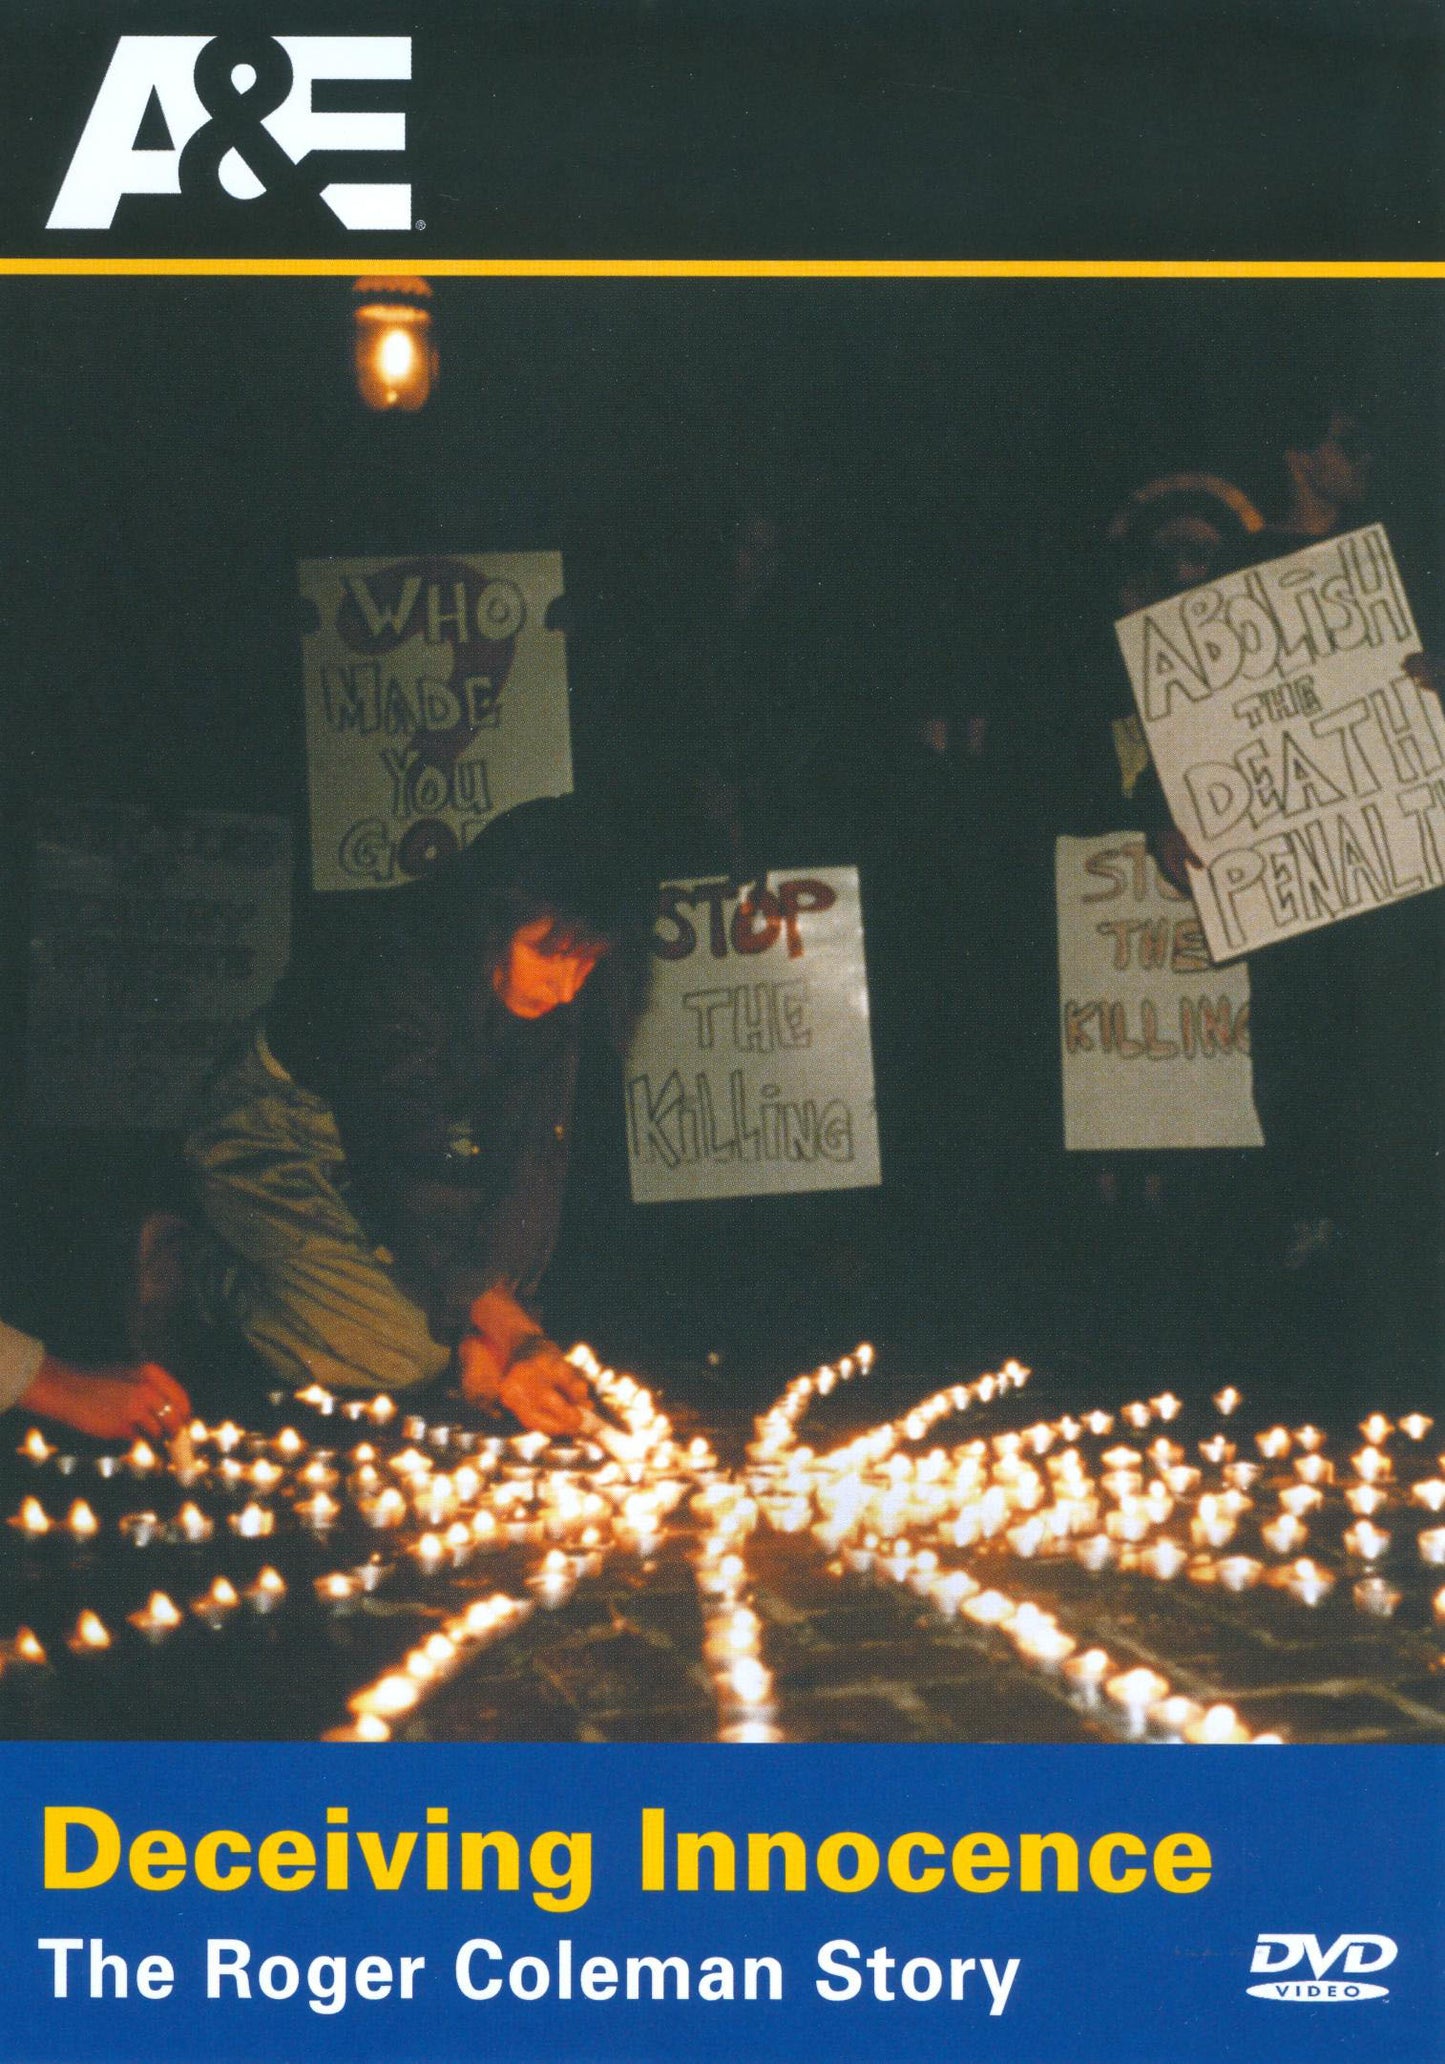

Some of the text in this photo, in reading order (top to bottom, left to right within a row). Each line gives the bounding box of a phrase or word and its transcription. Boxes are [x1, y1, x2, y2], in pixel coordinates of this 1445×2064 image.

[338, 573, 527, 645] WHO
[321, 660, 500, 737] MADE
[1231, 674, 1323, 729] THE
[381, 745, 491, 817] YOU
[1184, 675, 1445, 842] DEATH
[1207, 778, 1445, 949] PENALT
[657, 878, 838, 960] STOP
[1096, 917, 1213, 974] THE
[682, 976, 813, 1053] THE
